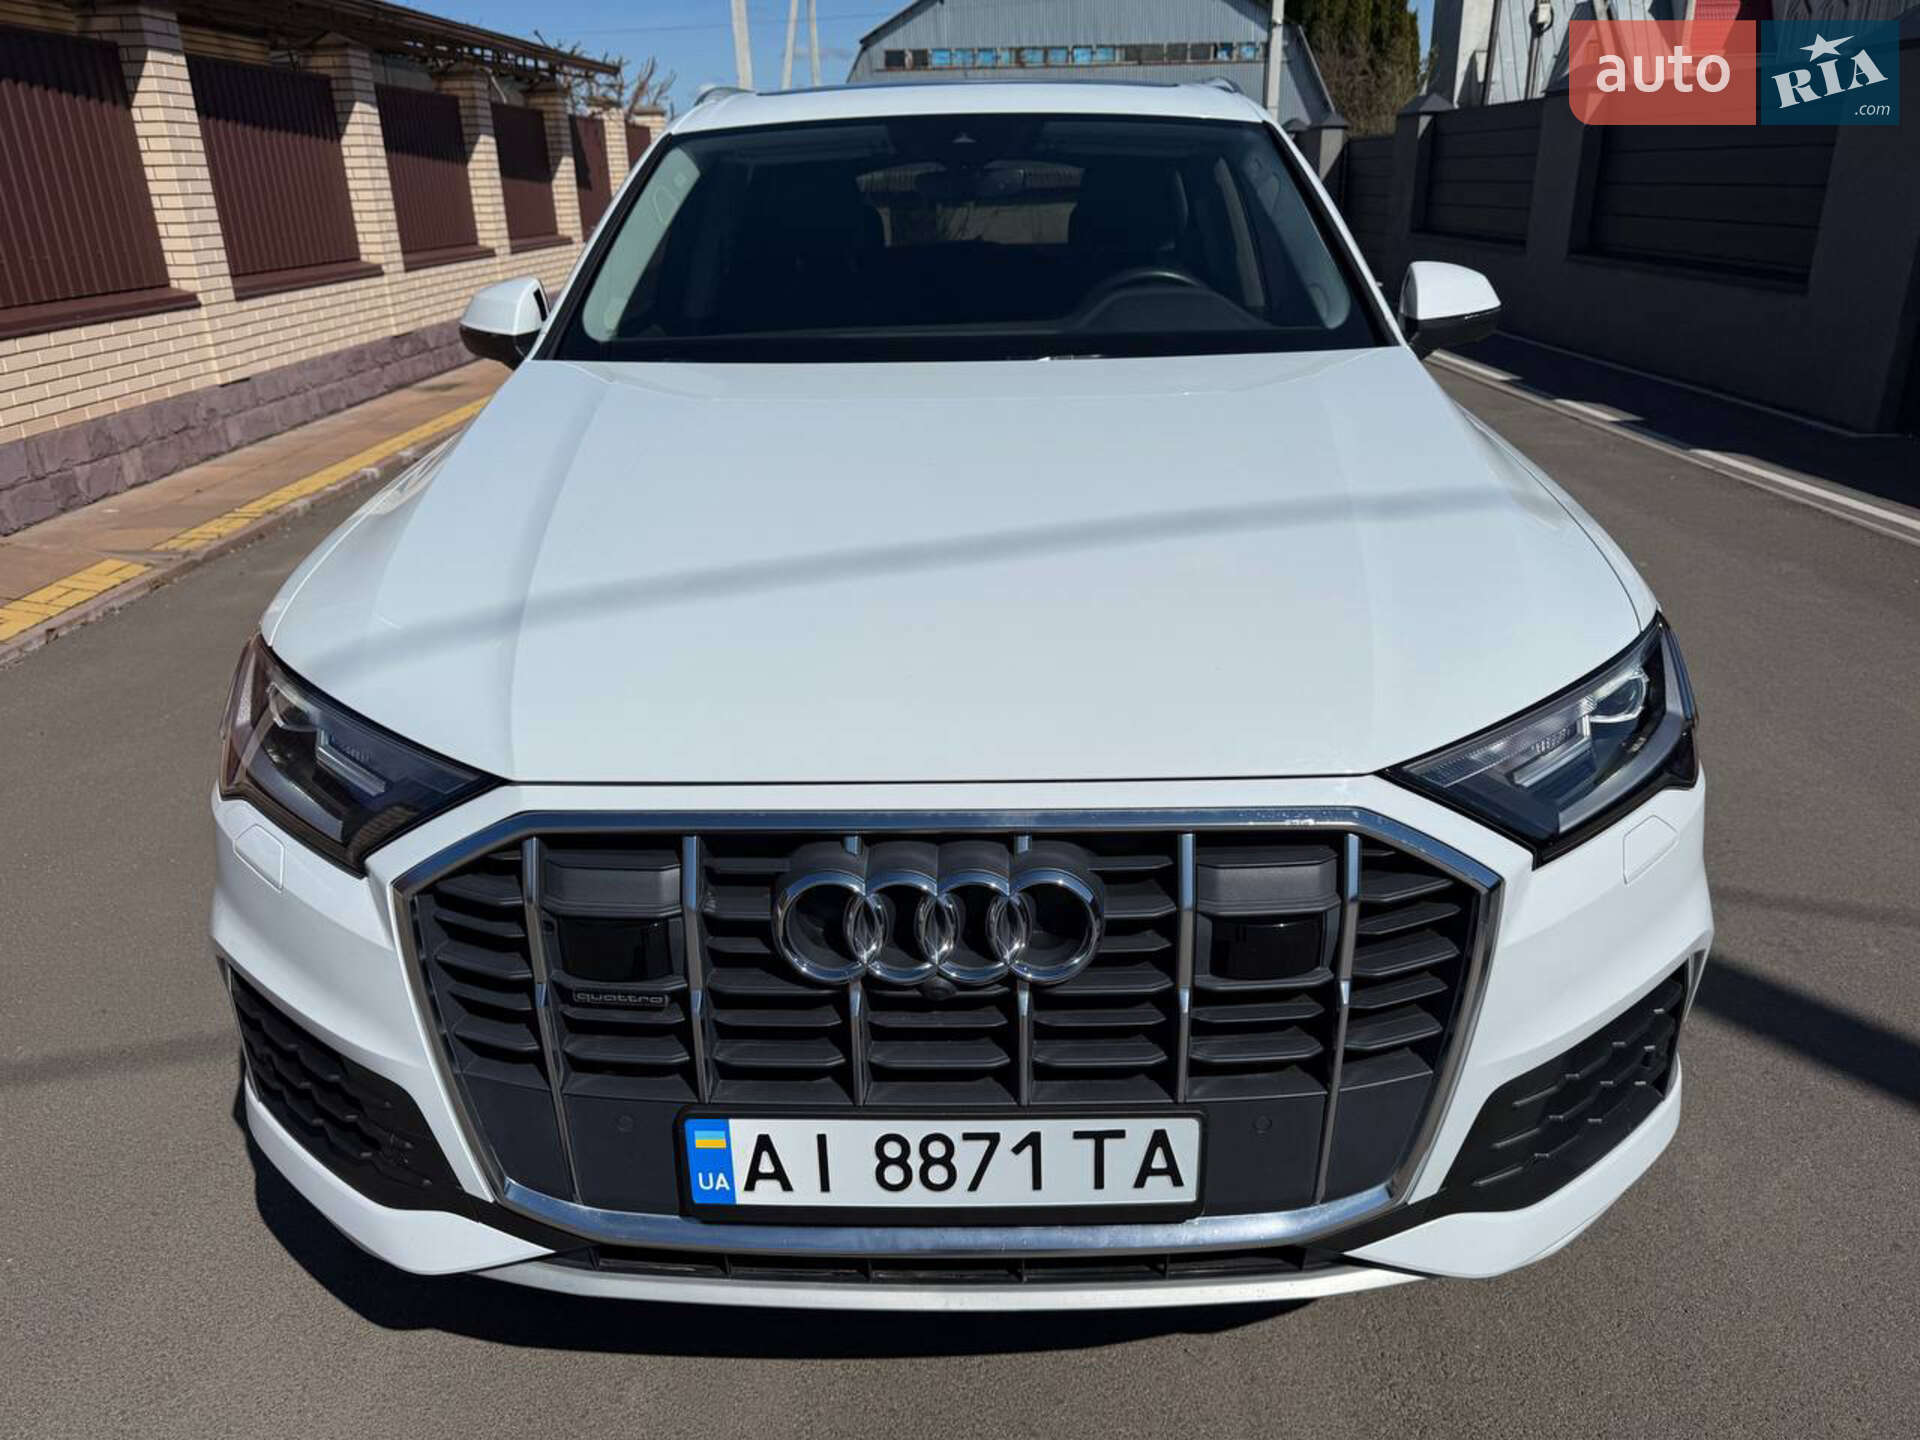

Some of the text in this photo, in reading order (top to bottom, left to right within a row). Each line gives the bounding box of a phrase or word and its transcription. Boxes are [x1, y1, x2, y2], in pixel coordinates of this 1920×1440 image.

[576, 991, 663, 1004] quattro
[743, 1129, 1185, 1193] AI 8871 TA
[699, 1172, 730, 1190] UA
